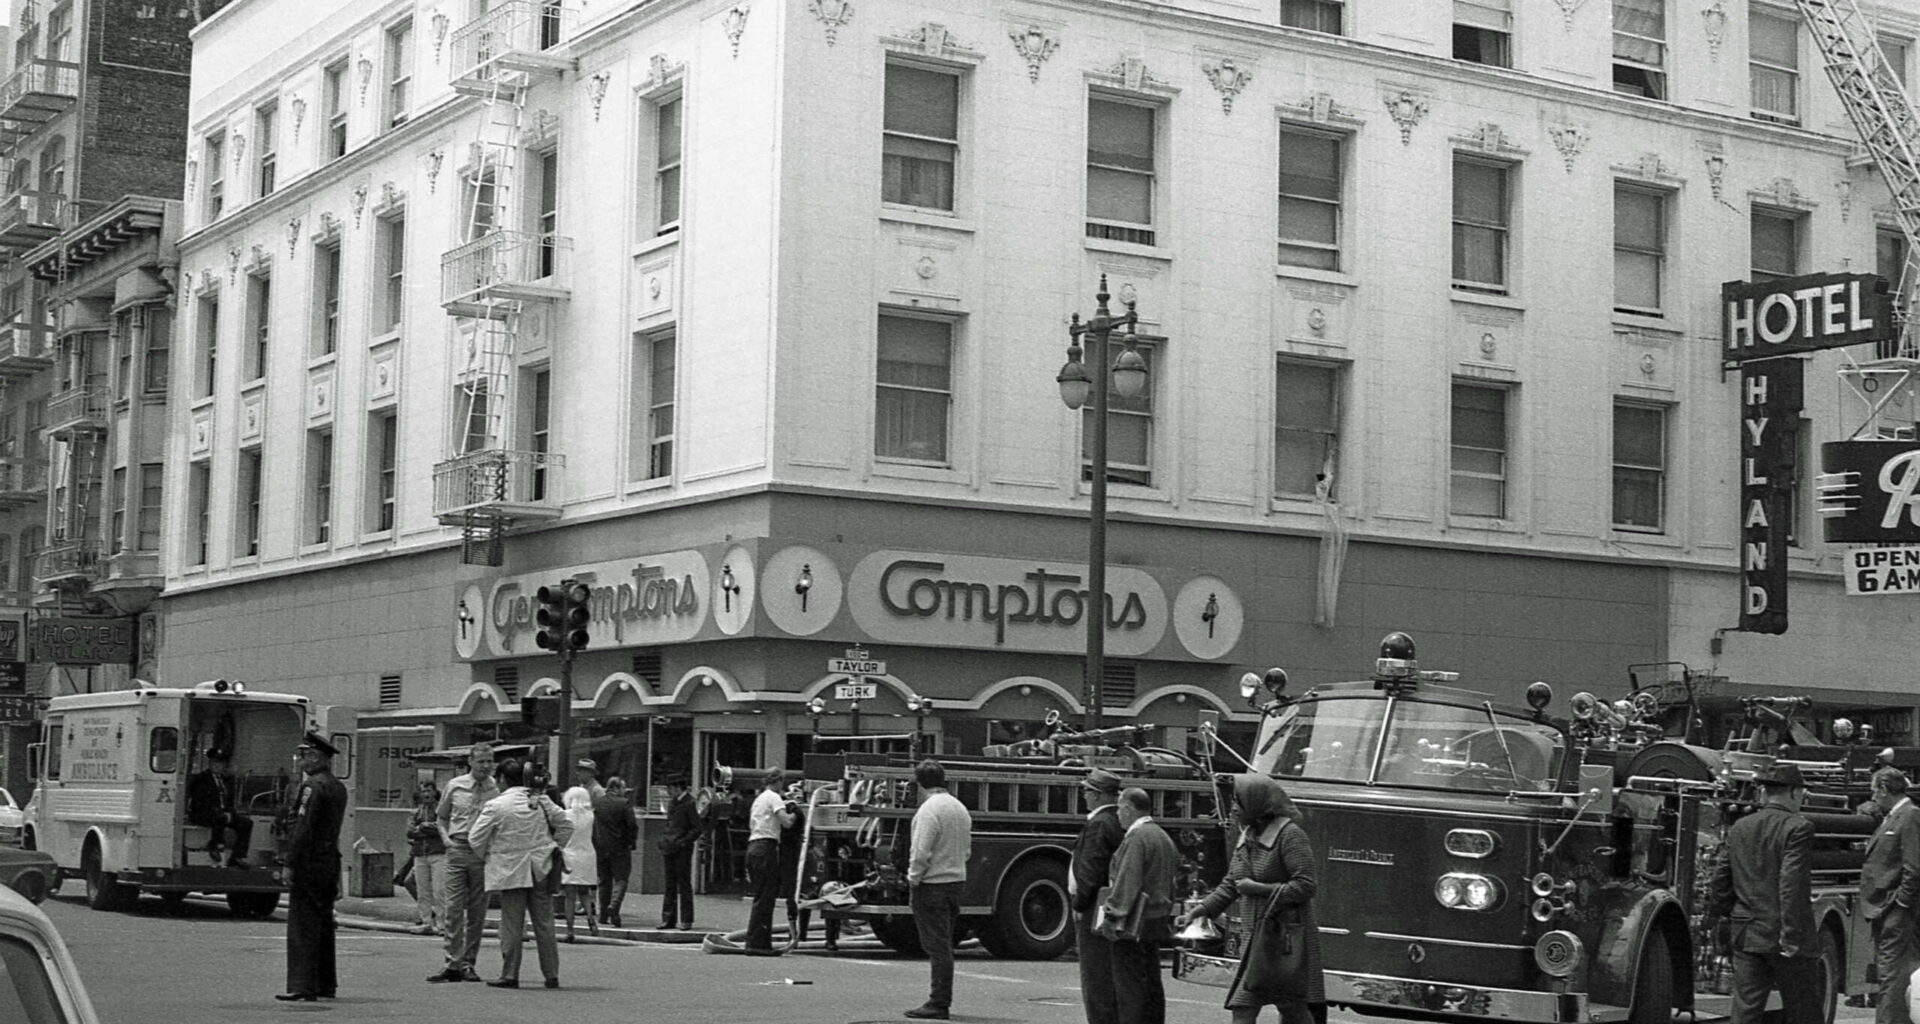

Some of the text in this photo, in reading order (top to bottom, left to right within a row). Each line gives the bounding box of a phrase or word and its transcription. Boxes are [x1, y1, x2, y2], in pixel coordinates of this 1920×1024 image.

[1728, 280, 1873, 350] HOTEL
[1745, 375, 1768, 616] HYLAND
[1855, 551, 1920, 568] OPEN
[43, 626, 127, 645] HOTEL
[836, 661, 879, 673] TAYLOR
[840, 687, 870, 698] TURK
